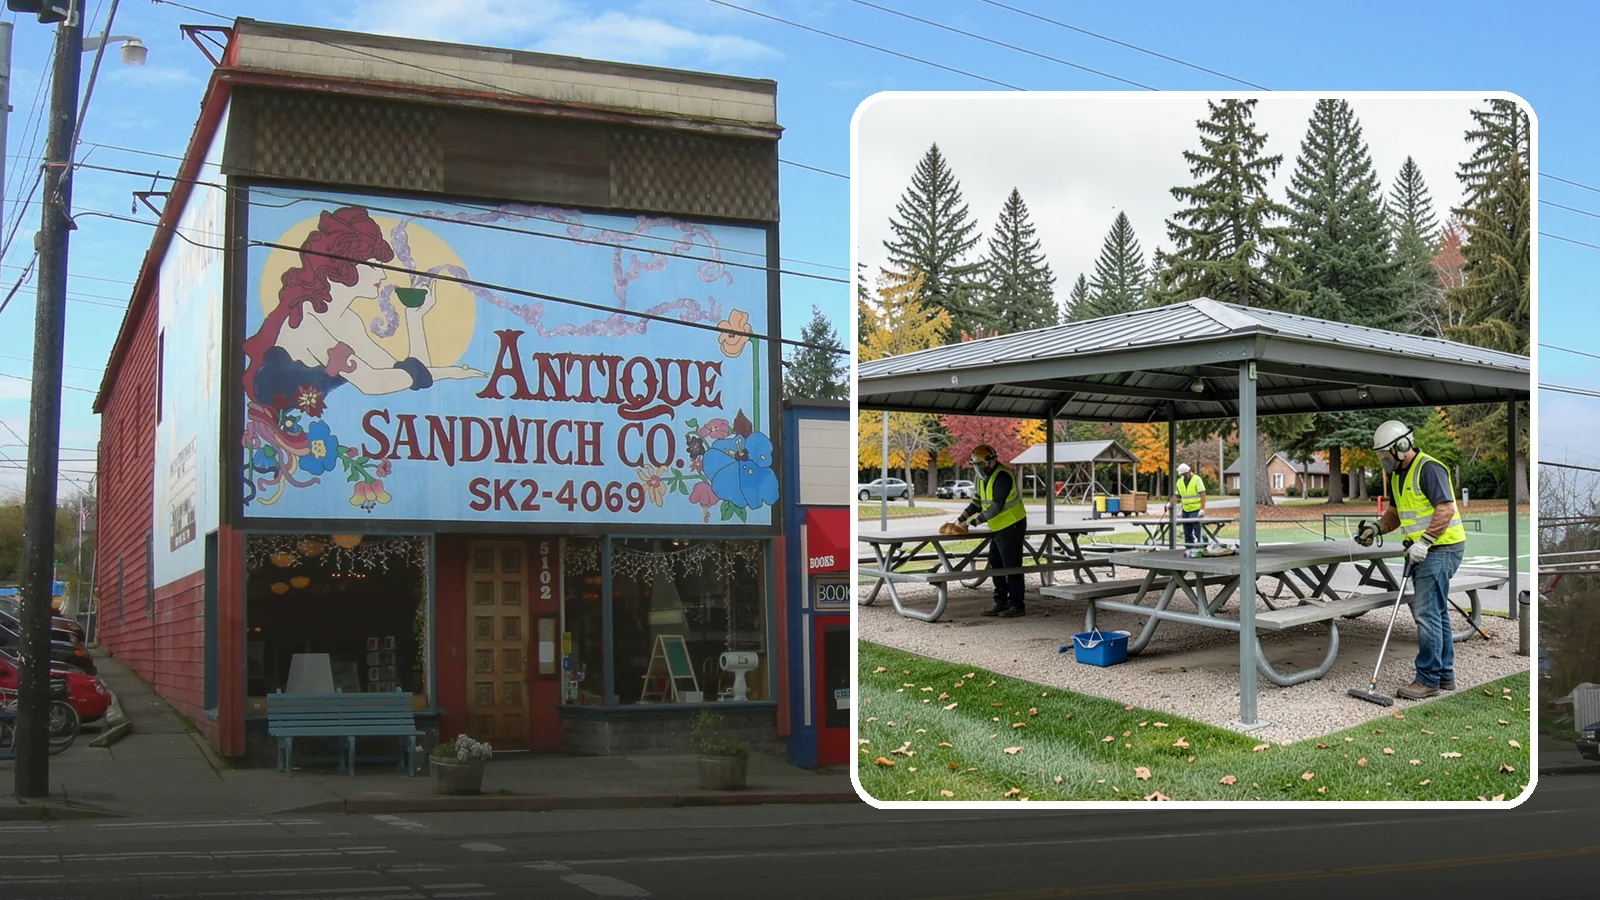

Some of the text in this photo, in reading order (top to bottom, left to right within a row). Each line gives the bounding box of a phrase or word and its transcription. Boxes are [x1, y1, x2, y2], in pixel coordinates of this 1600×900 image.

[476, 329, 723, 421] ANTIQUE
[361, 409, 684, 469] SANDWICH CO.
[469, 477, 646, 513] SK2-4069
[539, 542, 552, 600] 5102
[809, 555, 835, 569] BOOKS
